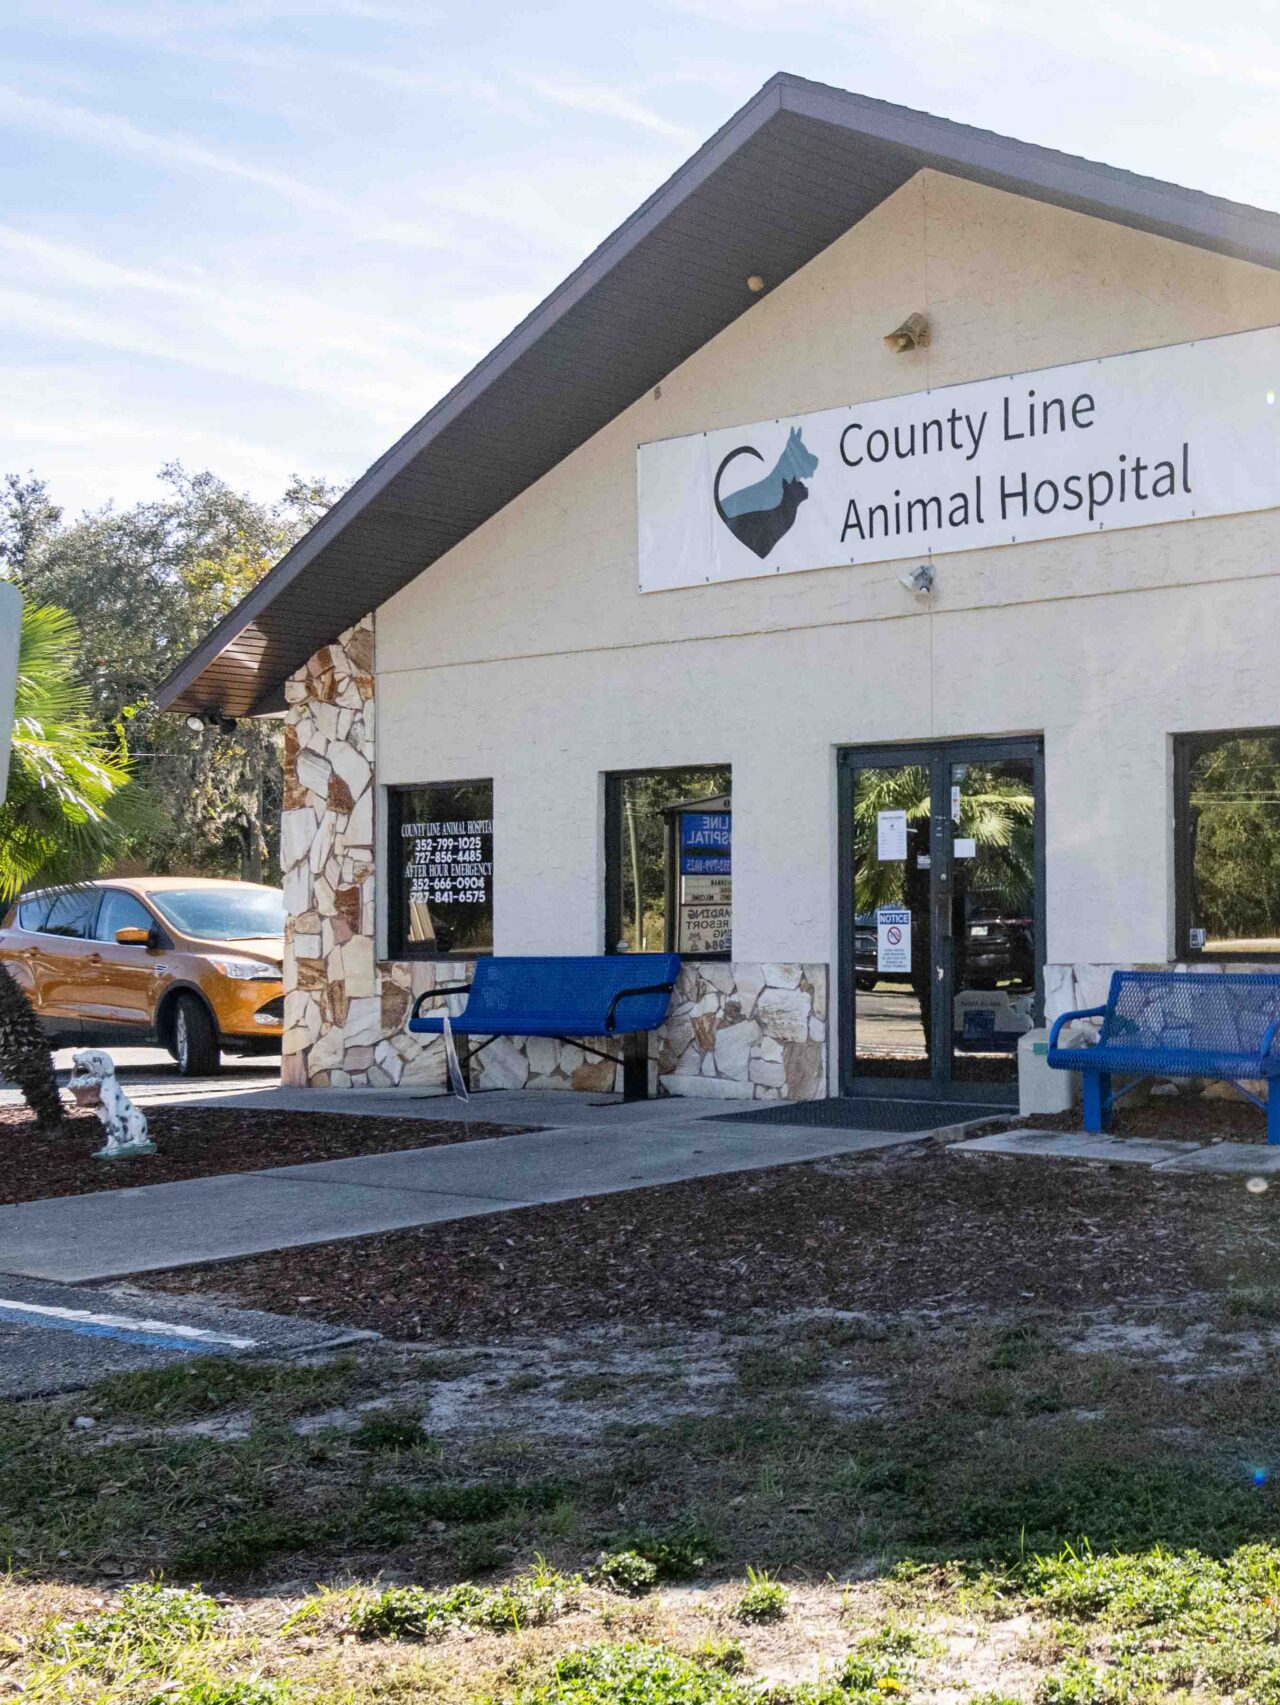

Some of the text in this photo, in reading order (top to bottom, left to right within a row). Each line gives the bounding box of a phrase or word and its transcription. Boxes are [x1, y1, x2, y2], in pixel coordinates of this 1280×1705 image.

[839, 389, 1096, 467] County Line
[840, 442, 1193, 543] Animal Hospital
[401, 820, 493, 837] COUNTY LINE ANIMAL HOSPITA
[415, 837, 482, 851] 352-799-1025
[415, 850, 482, 864] 727-856-4485
[405, 862, 493, 878] AFTER HOUR EMERGENCY
[412, 877, 485, 890] 352-666-0904
[410, 891, 486, 904] 727-841-6575
[880, 914, 909, 924] NOTICE
